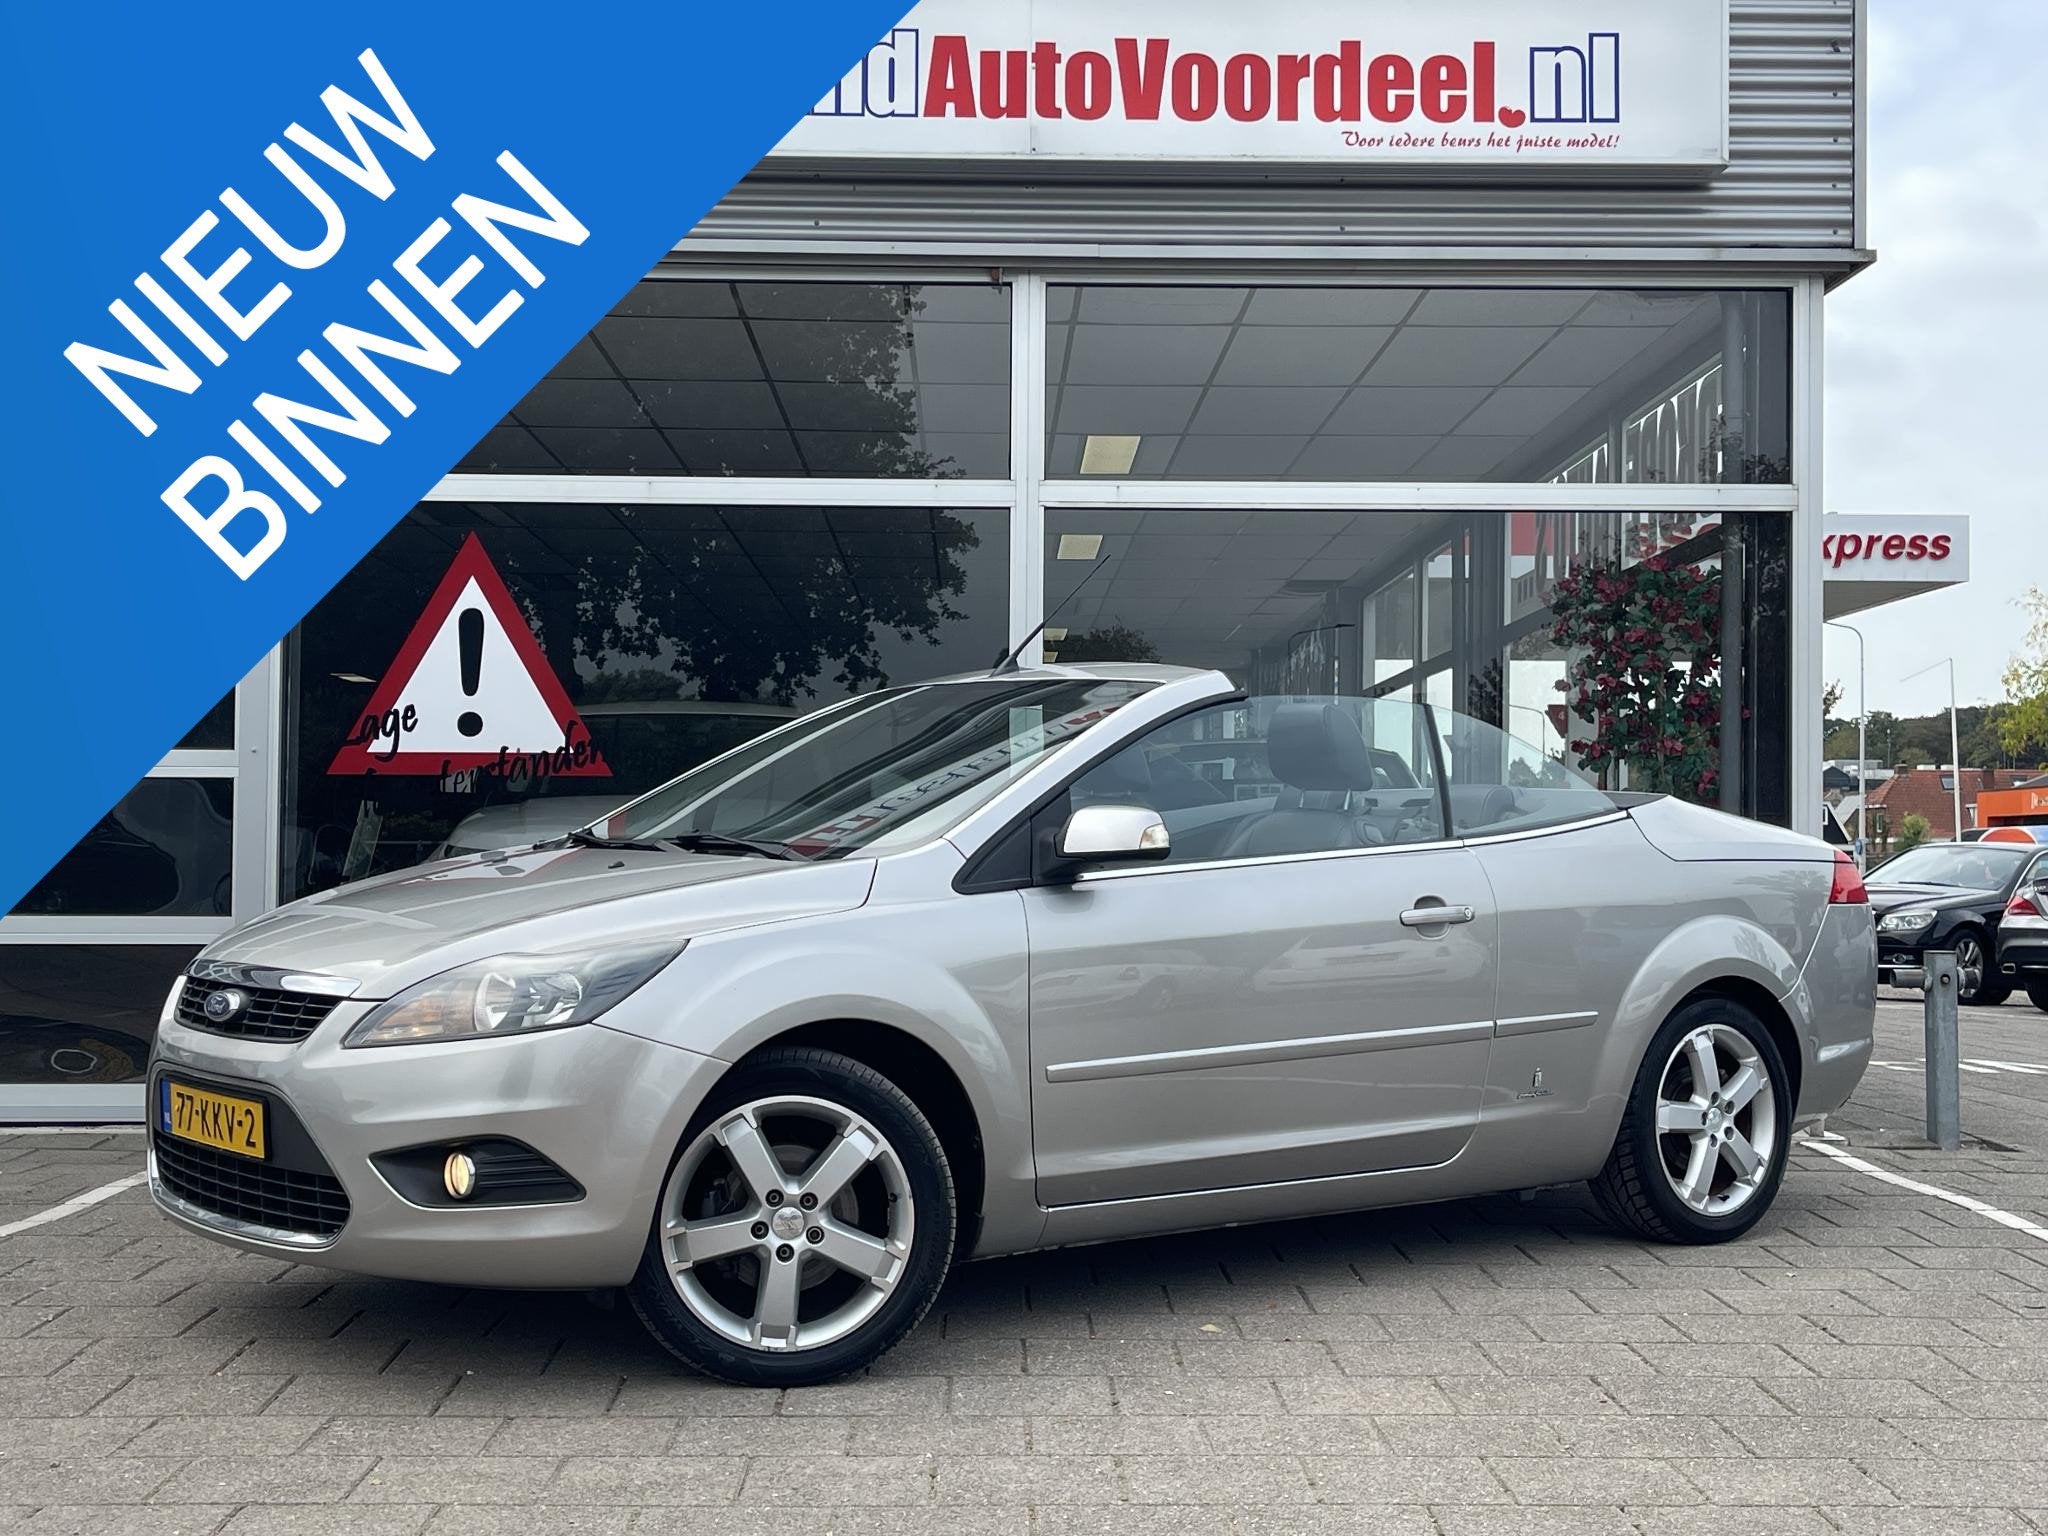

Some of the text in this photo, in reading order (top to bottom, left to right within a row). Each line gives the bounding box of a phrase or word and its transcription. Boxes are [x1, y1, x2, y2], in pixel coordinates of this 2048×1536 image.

[1341, 131, 1620, 153] Voor iedere beurs het juiste model!
[176, 1091, 257, 1149] 77-KKV-2
